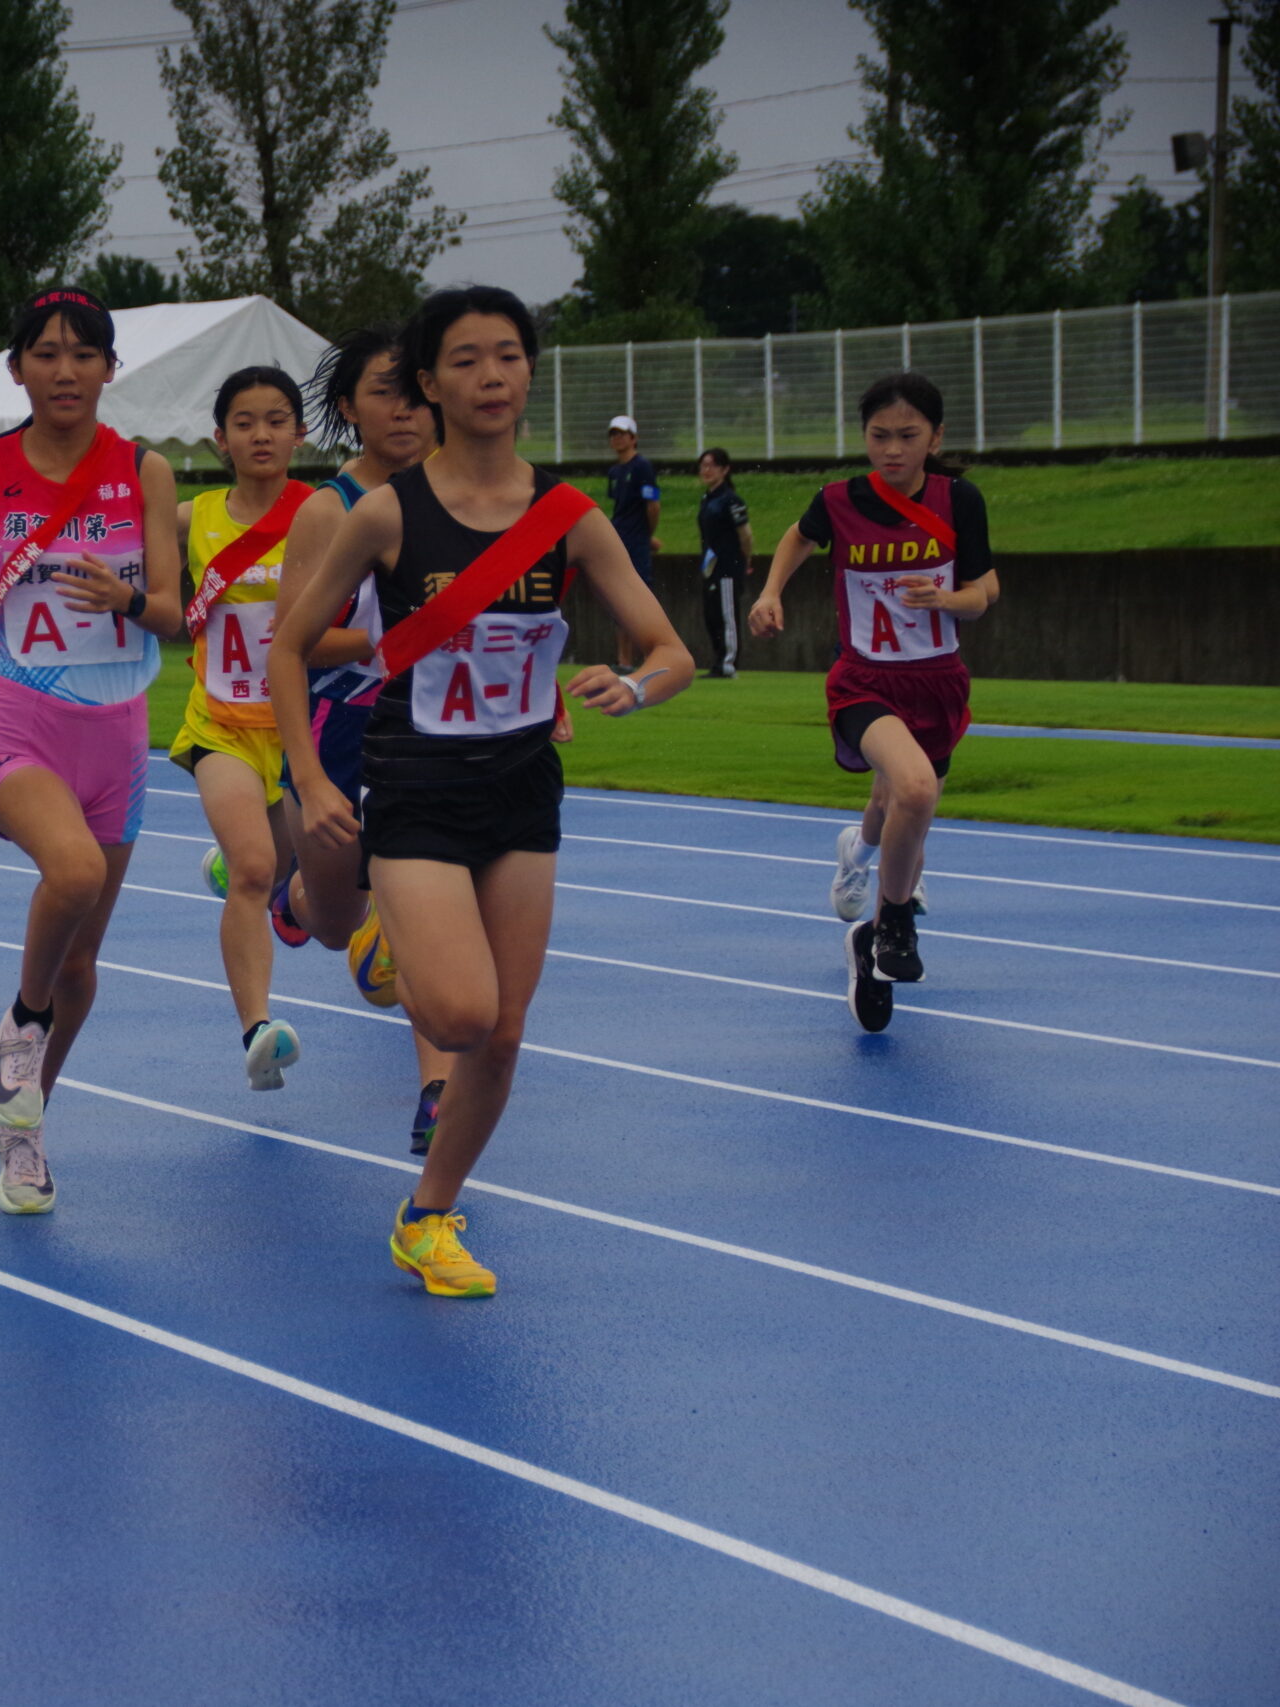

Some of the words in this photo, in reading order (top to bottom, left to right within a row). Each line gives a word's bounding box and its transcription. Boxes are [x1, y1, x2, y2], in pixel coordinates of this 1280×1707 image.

[98, 482, 132, 501] 福島
[848, 537, 941, 565] NIIDA
[233, 563, 283, 585] 袋中
[423, 571, 554, 604] 須川三
[860, 573, 946, 597] 仁井中
[21, 602, 126, 654] A-1
[870, 599, 944, 654] A-1
[223, 613, 273, 674] A-
[440, 652, 534, 722] A-1
